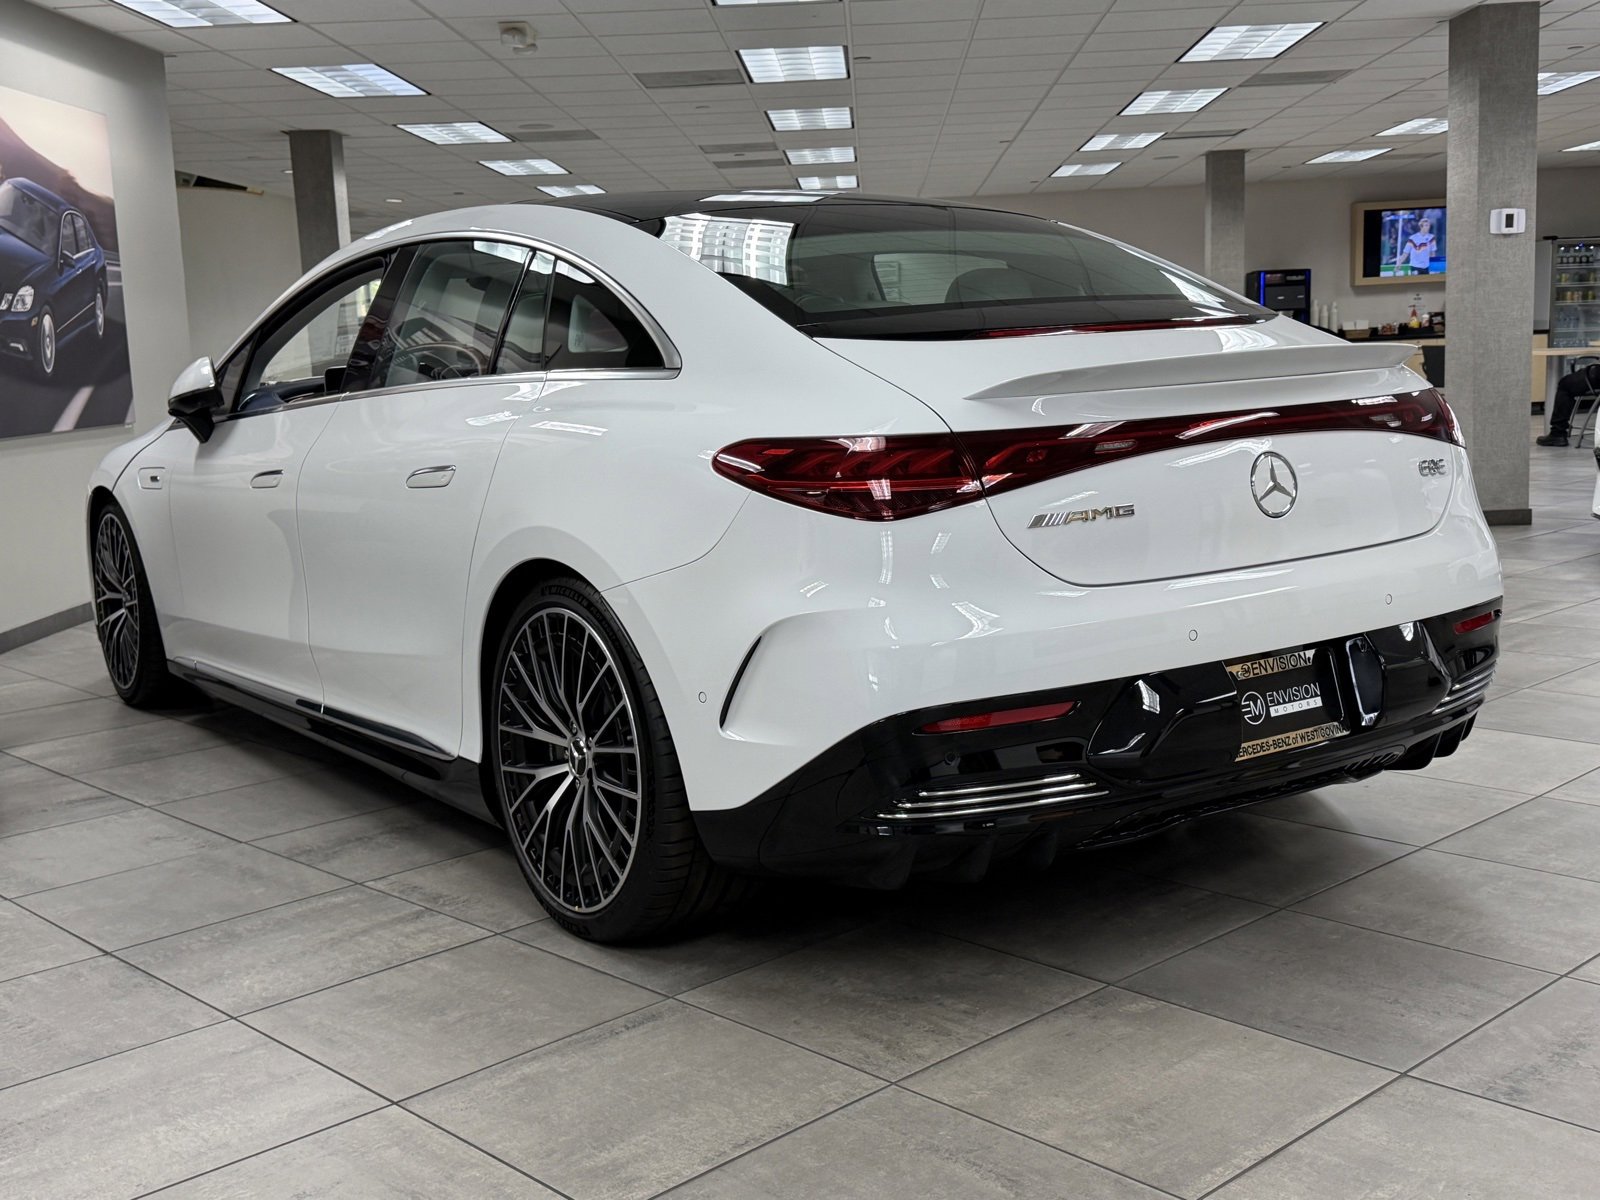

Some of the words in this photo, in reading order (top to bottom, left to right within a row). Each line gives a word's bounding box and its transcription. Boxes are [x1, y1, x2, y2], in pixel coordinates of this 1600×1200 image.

[1065, 503, 1135, 525] AMG
[549, 585, 590, 608] MICHELIN
[1251, 651, 1308, 676] ENVISION
[1266, 682, 1321, 706] ENVISION
[1273, 699, 1319, 714] MOTORS
[1238, 735, 1292, 758] ERCEDES-BENZ
[1292, 733, 1299, 746] of
[1299, 728, 1320, 743] WEST
